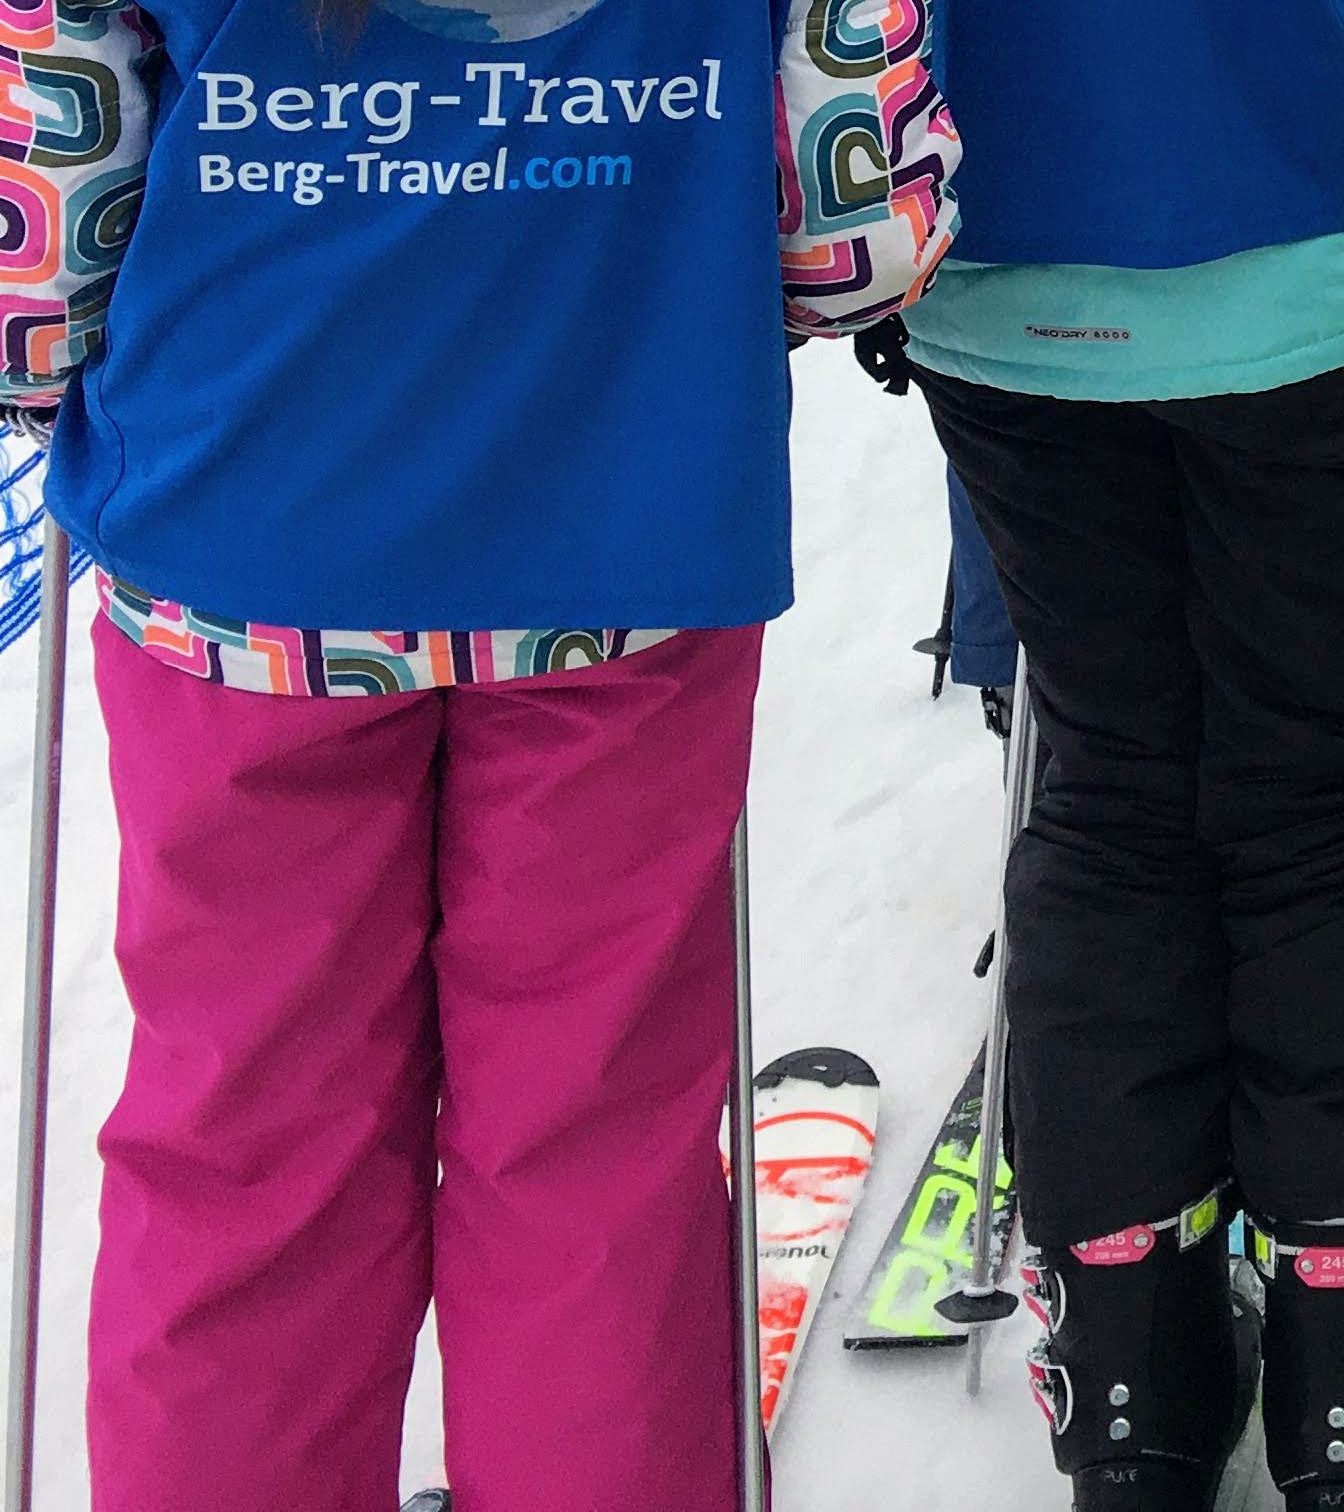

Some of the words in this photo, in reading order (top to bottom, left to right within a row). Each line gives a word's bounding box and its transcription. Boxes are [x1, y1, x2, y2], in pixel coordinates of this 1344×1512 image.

[198, 59, 722, 144] Berg-Travel
[199, 147, 632, 206] Berg-Travel.com
[1096, 1231, 1126, 1247] 245
